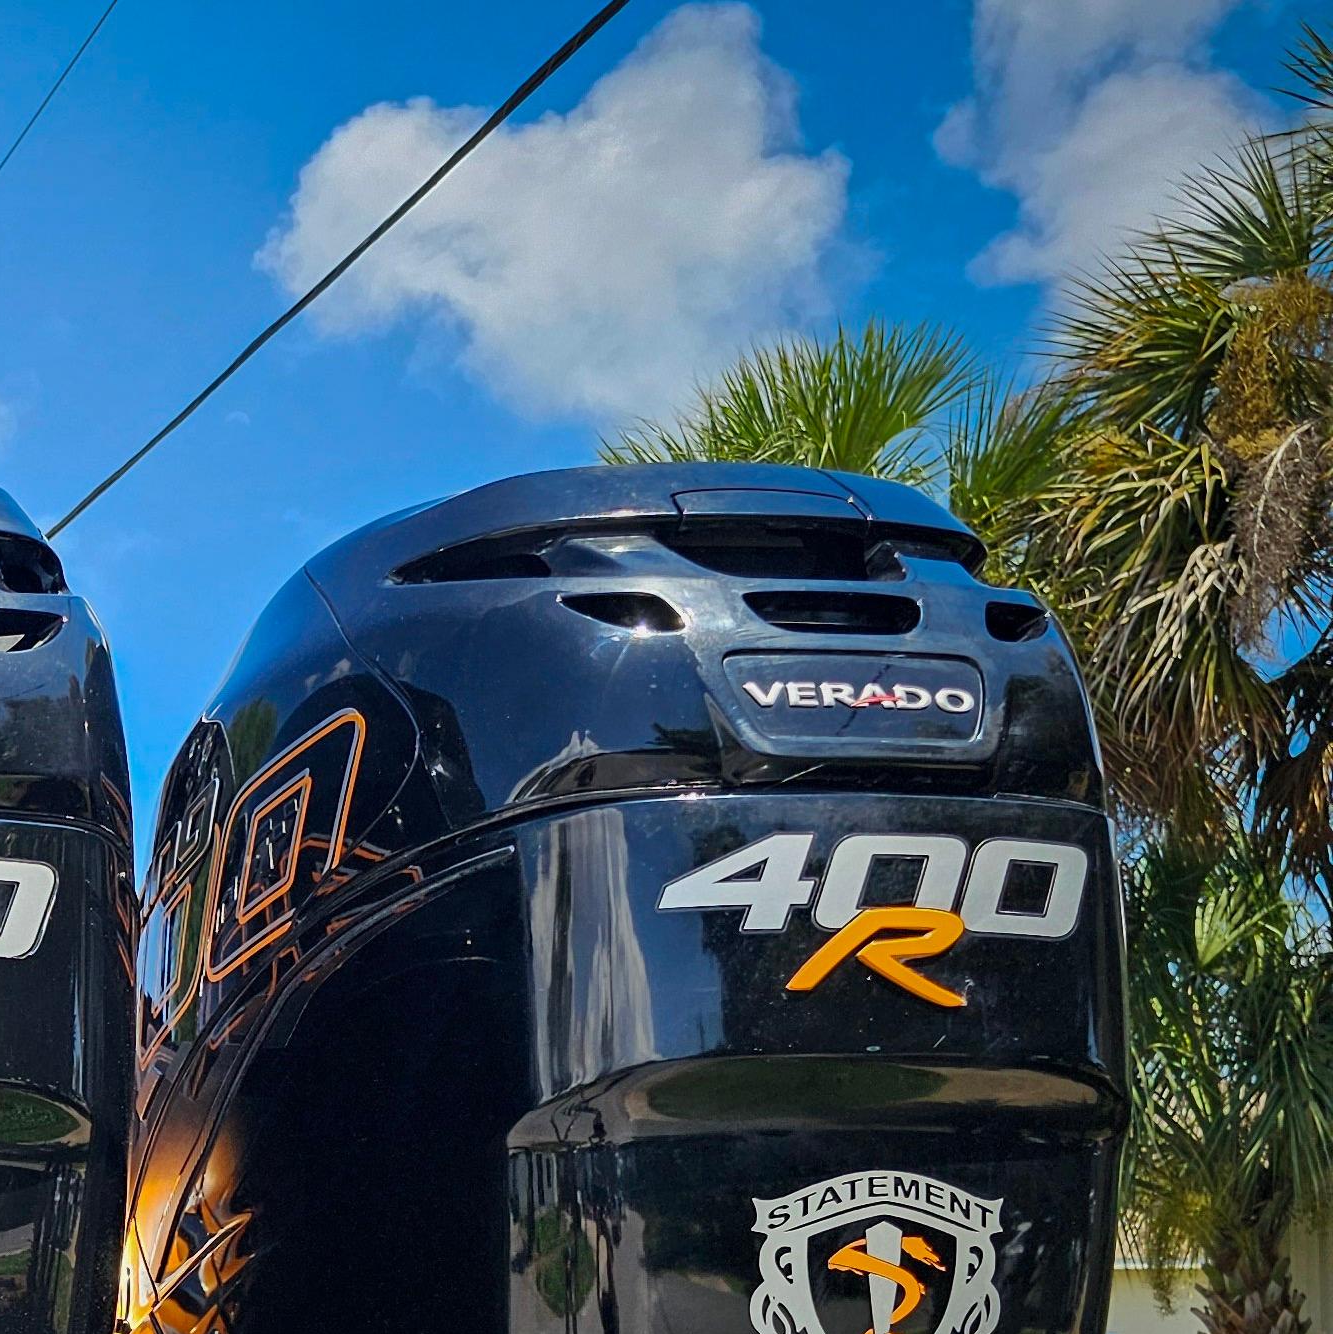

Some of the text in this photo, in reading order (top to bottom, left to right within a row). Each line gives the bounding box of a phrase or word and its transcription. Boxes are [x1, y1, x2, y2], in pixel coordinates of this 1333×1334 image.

[742, 680, 975, 714] VERADO
[657, 833, 1087, 939] 400
[786, 906, 967, 1007] R
[766, 1175, 994, 1230] STATEMENT
